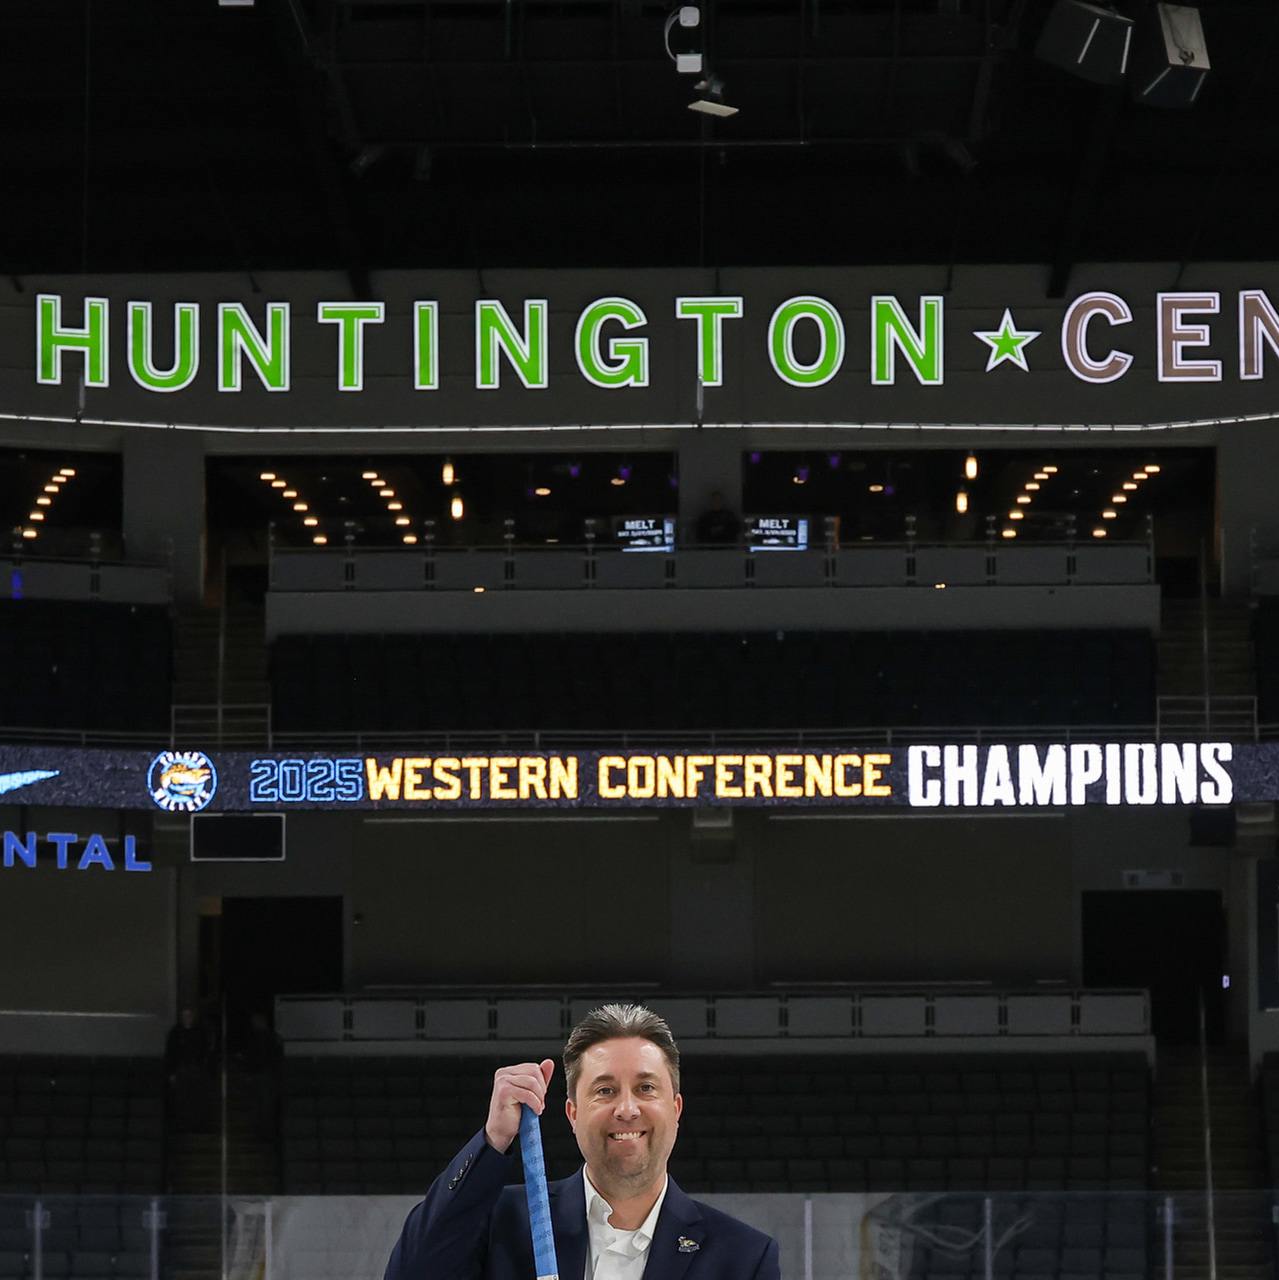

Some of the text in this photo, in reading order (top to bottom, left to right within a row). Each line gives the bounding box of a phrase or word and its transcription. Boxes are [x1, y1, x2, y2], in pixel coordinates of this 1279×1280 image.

[35, 293, 944, 393] HUNTINGTON
[249, 742, 1235, 807] 2025 WESTERN CONFERENCE CHAMPIONS
